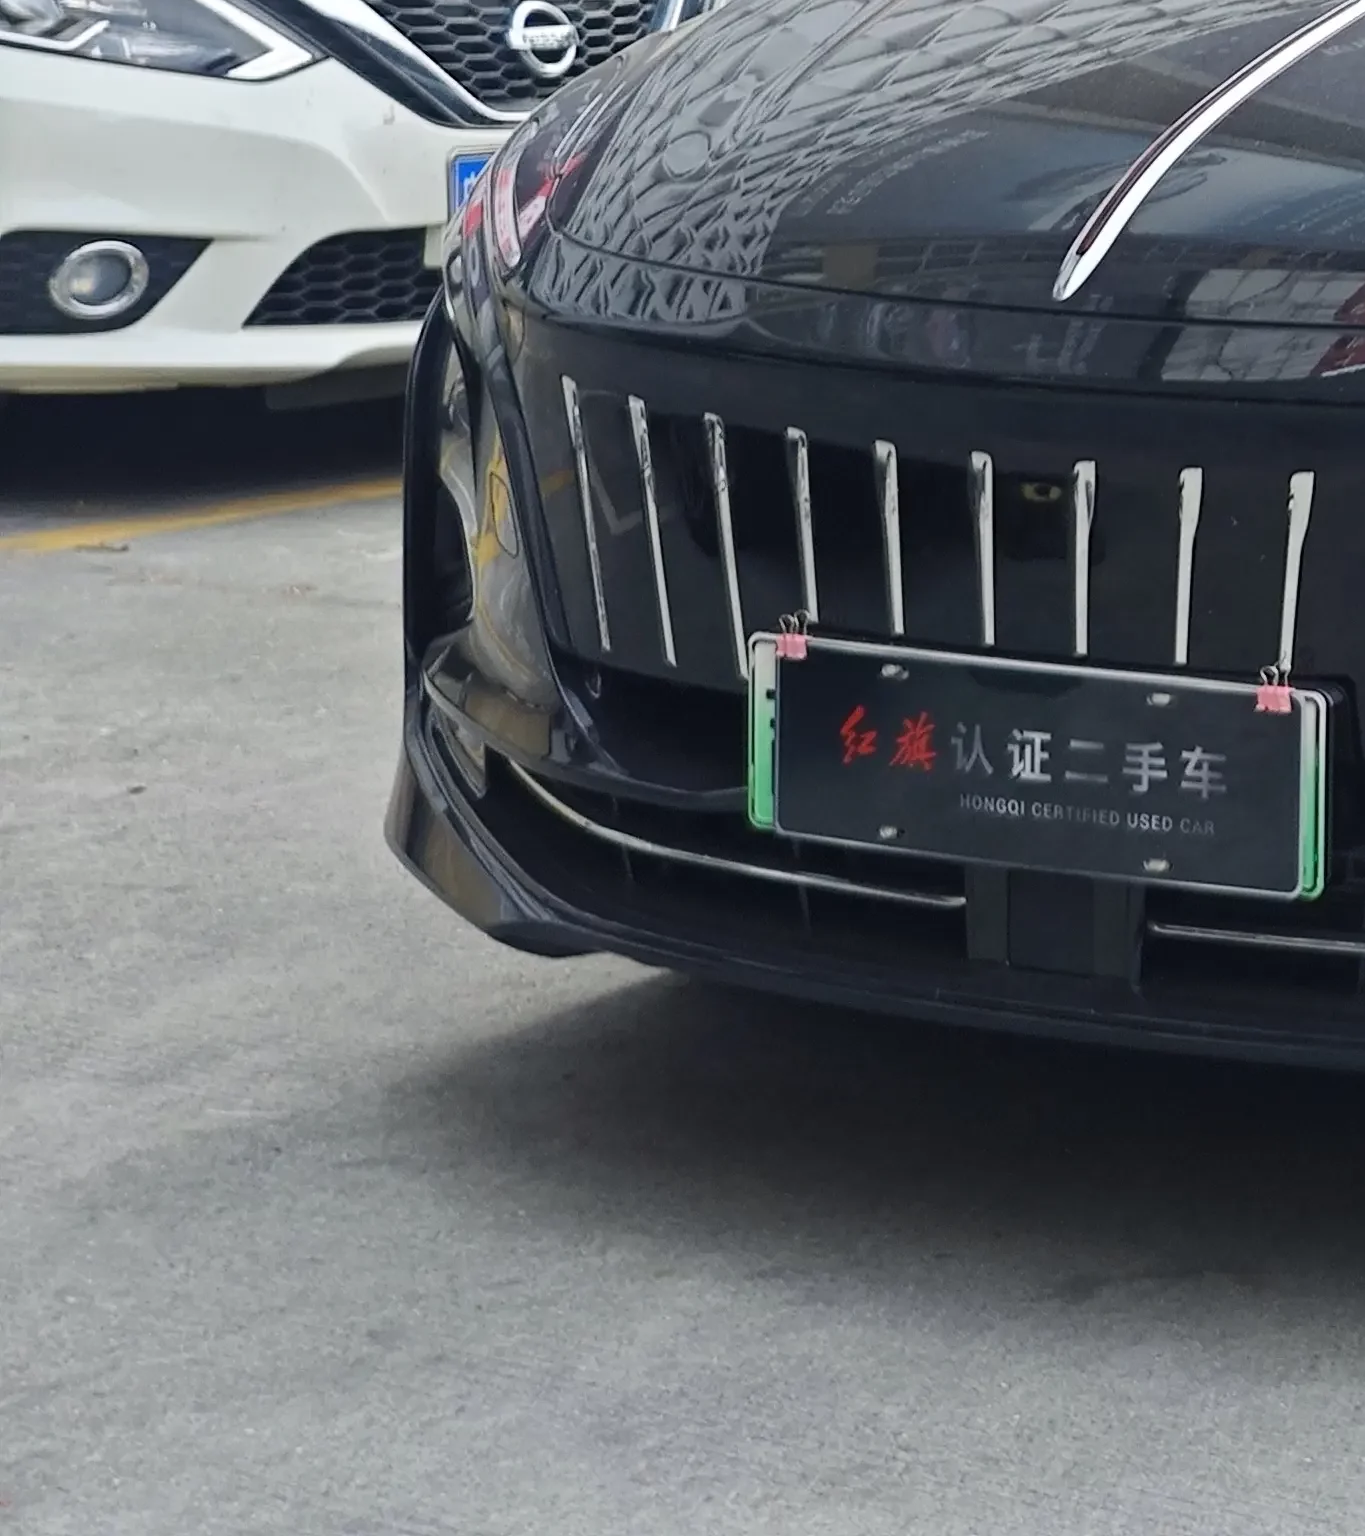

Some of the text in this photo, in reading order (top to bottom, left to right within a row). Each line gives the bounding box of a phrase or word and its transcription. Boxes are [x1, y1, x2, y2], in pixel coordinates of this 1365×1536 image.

[839, 704, 1228, 799] 红旗认证二手车
[959, 793, 1216, 836] HONGQI CERTIFIED USED CAR
